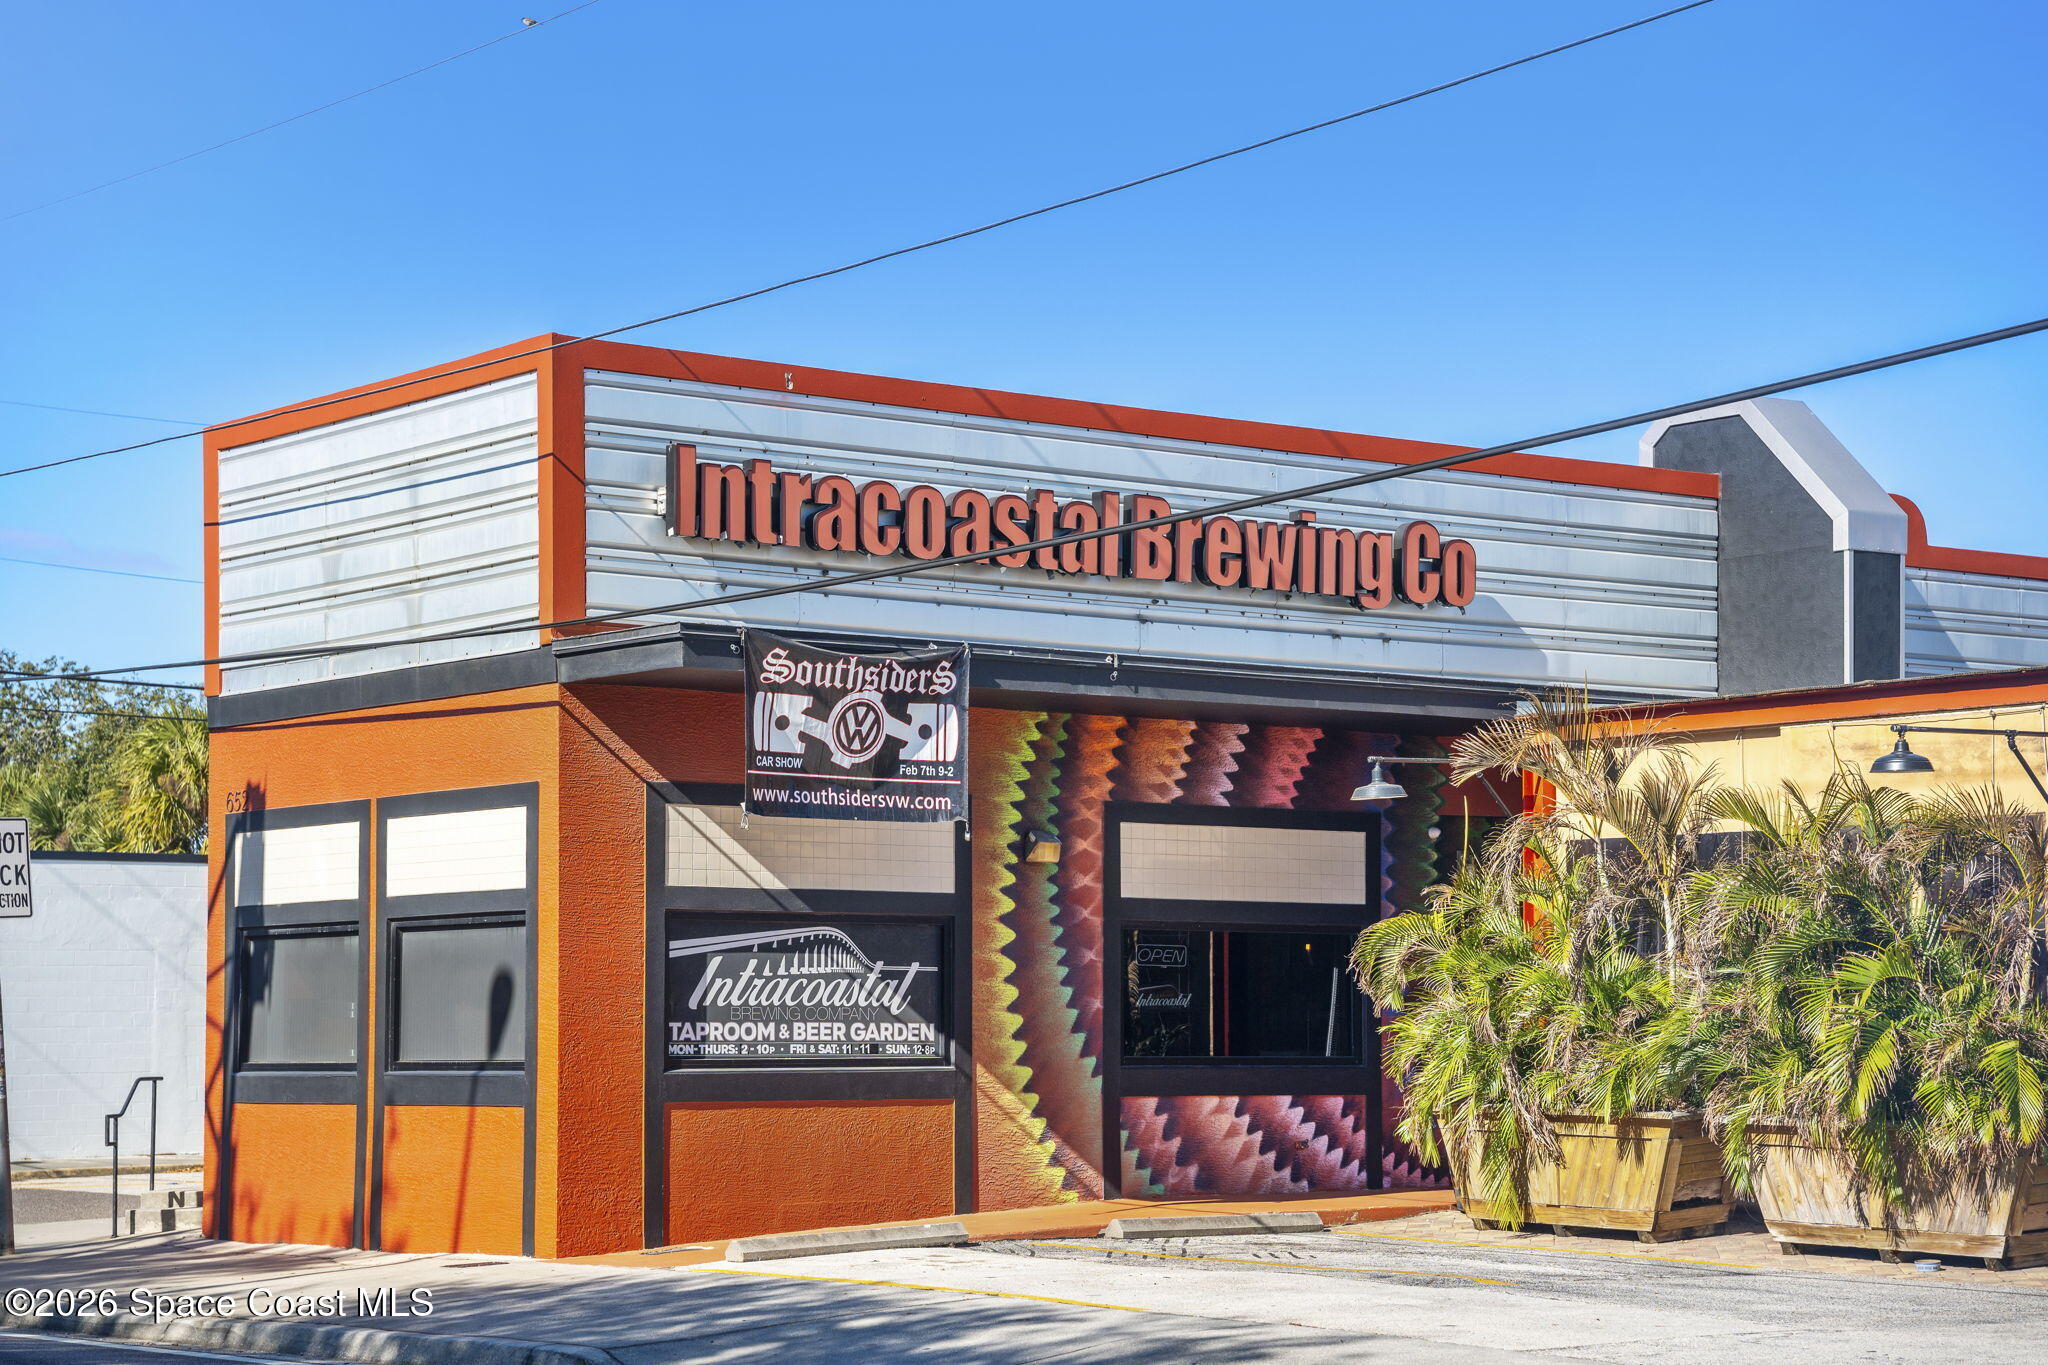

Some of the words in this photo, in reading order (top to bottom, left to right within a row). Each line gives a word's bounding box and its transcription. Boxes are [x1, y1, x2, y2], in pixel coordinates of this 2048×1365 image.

[666, 443, 1120, 578] Intracoastal
[1124, 494, 1393, 610] Brewing
[1398, 520, 1477, 607] Co
[756, 755, 775, 767] CAR
[775, 757, 803, 769] SHOW
[899, 764, 918, 776] Feb
[919, 765, 936, 777] 7th
[938, 766, 954, 777] 9-2
[752, 787, 952, 810] www.southsidersvw.com
[0, 832, 25, 853] OT
[1138, 948, 1185, 963] OPEN
[688, 955, 920, 1015] Intracoastal
[730, 1006, 802, 1021] BREWING
[804, 1006, 880, 1021] COMPANY
[668, 1021, 775, 1041] TAPROOM
[778, 1023, 790, 1040] &
[792, 1022, 847, 1041] BEER
[849, 1022, 935, 1041] GARDEN
[789, 1044, 807, 1054] FRI
[809, 1045, 816, 1053] &
[818, 1044, 840, 1054] SAT:
[885, 1044, 911, 1055] SUN:
